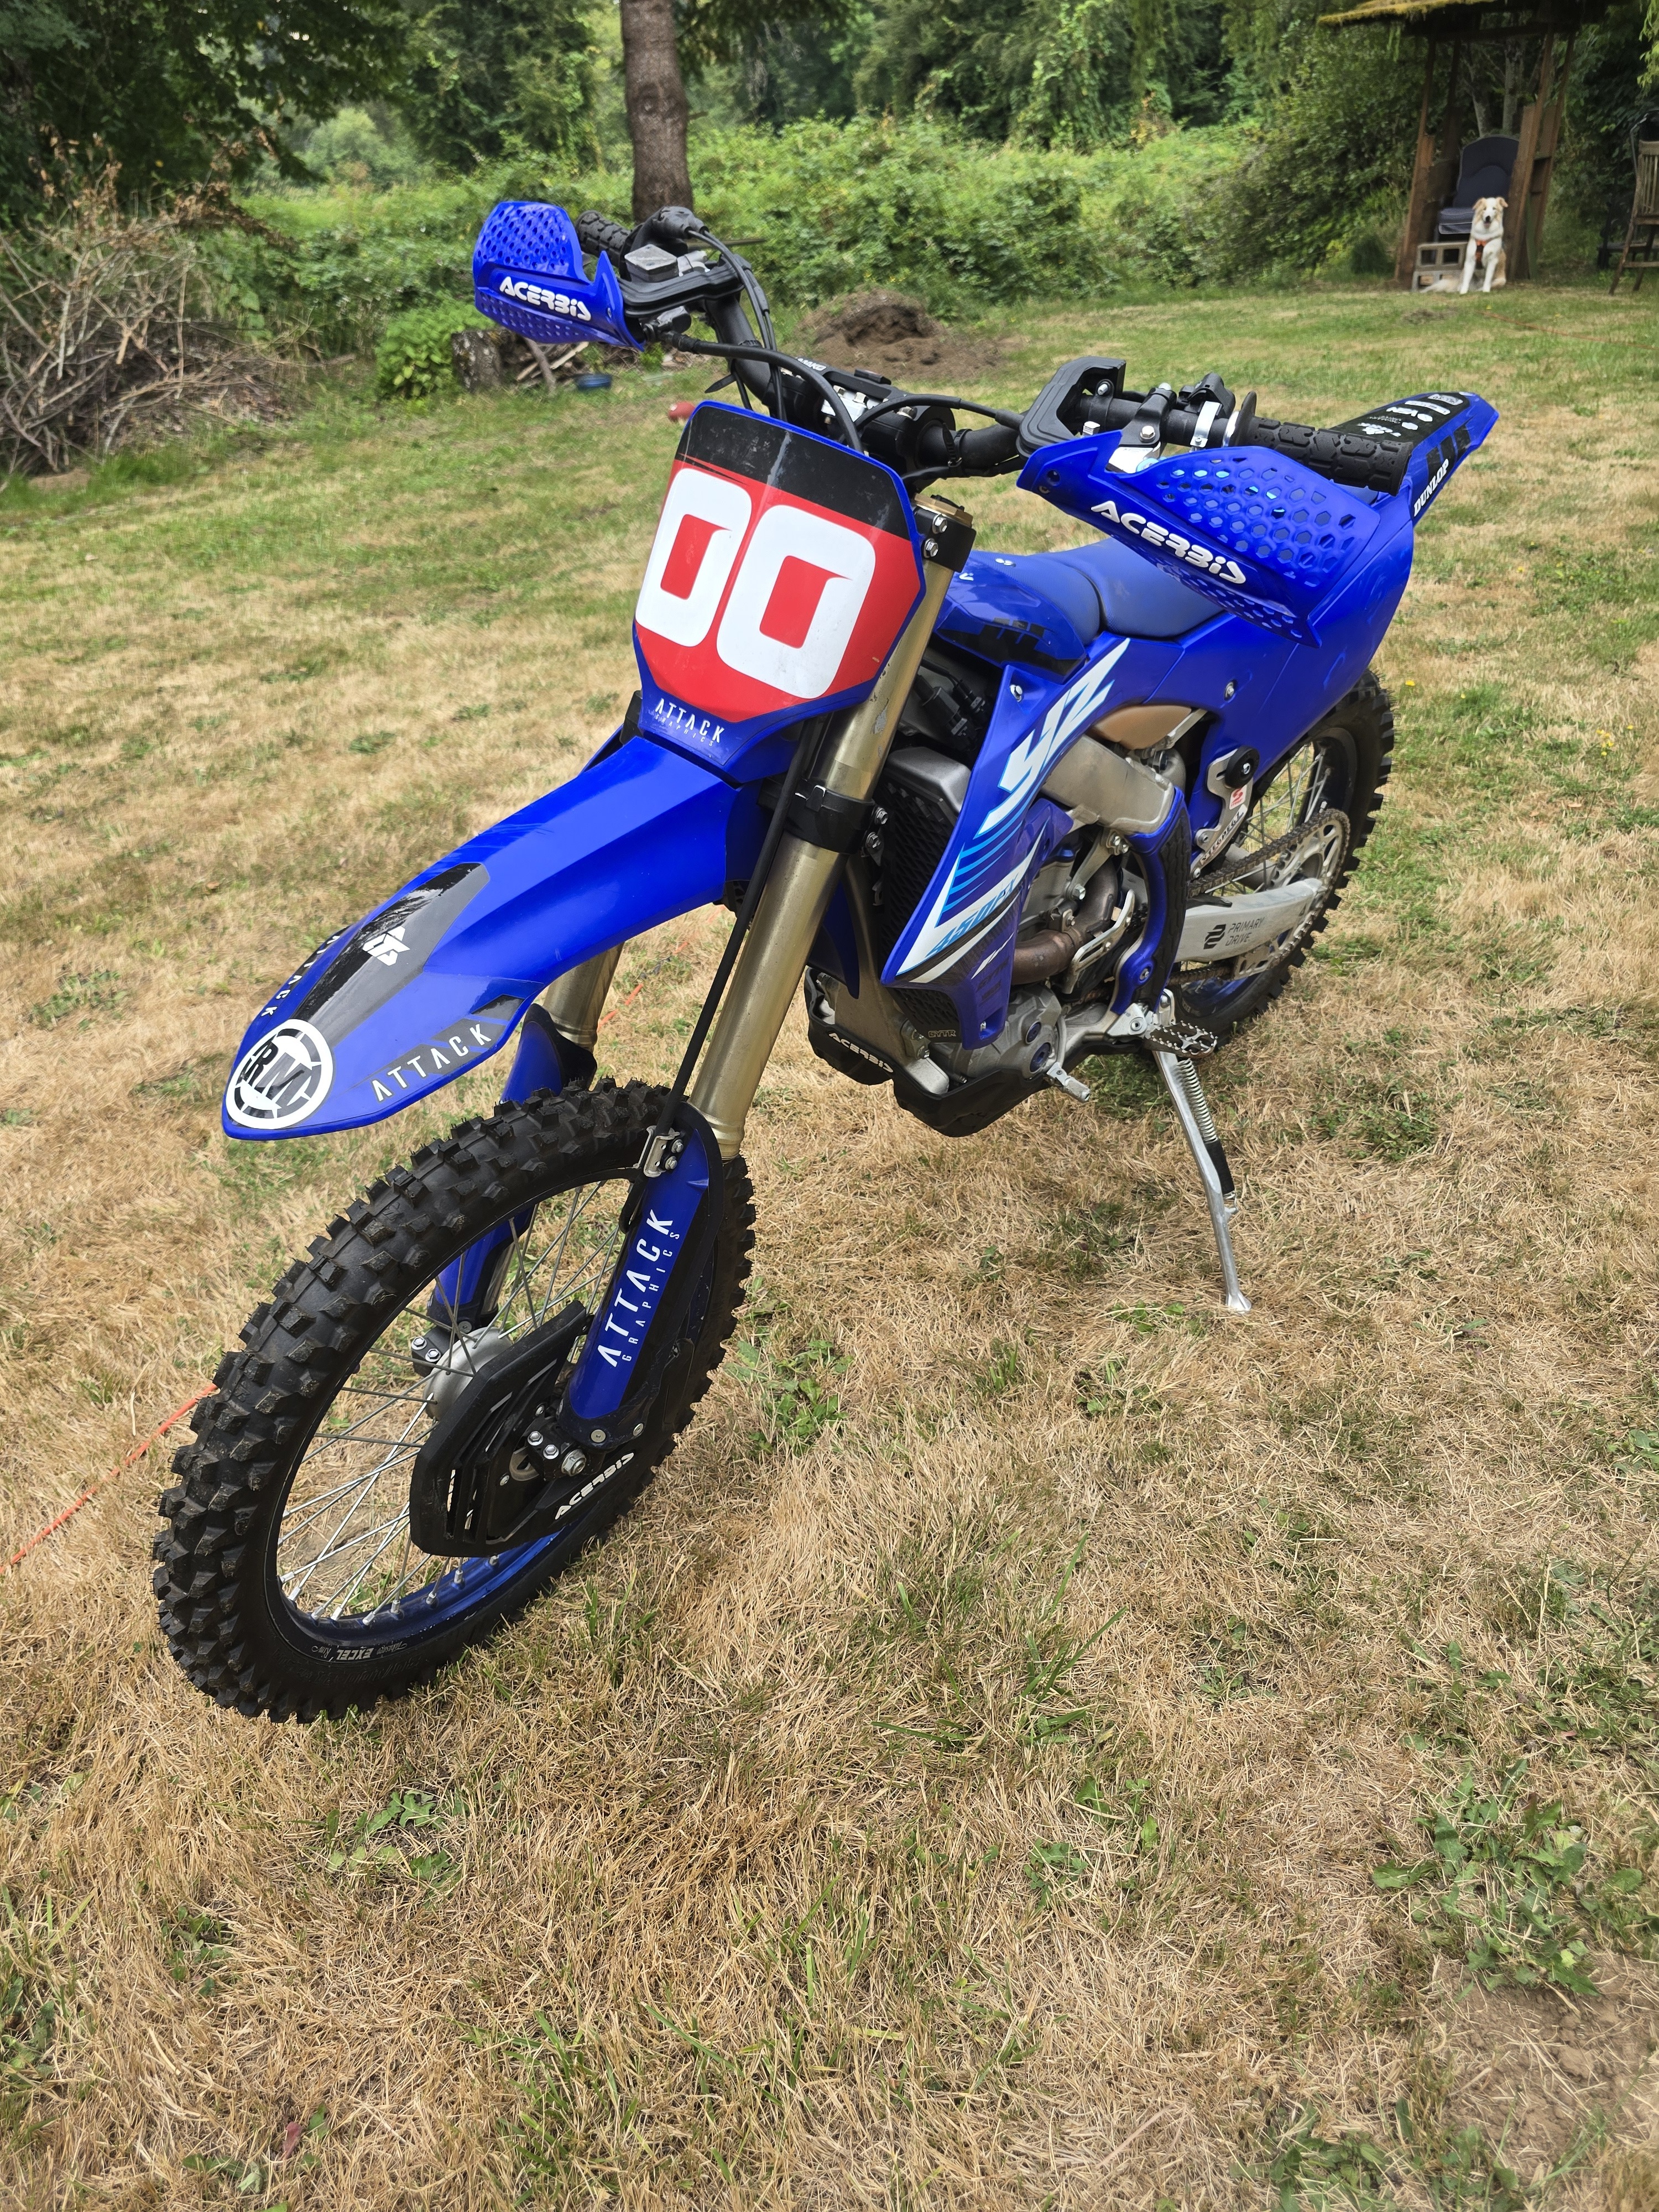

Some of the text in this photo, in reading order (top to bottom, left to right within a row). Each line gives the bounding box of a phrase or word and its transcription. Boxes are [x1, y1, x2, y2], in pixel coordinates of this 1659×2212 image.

[500, 276, 591, 321] ACERBIS
[1414, 458, 1449, 517] DUNLOP
[1091, 500, 1246, 585] ACERBIS
[635, 467, 876, 699] 00
[655, 697, 725, 743] ATTACK
[973, 638, 1131, 839] YZ
[1225, 932, 1252, 946] DRIVE
[1228, 916, 1265, 934] PRIMARY
[371, 1023, 492, 1102] ATTACK
[928, 1029, 957, 1038] GYTR
[597, 1209, 674, 1368] ATTACK
[622, 1230, 680, 1362] GRAPHICS
[336, 1647, 374, 1660] EXCEL
